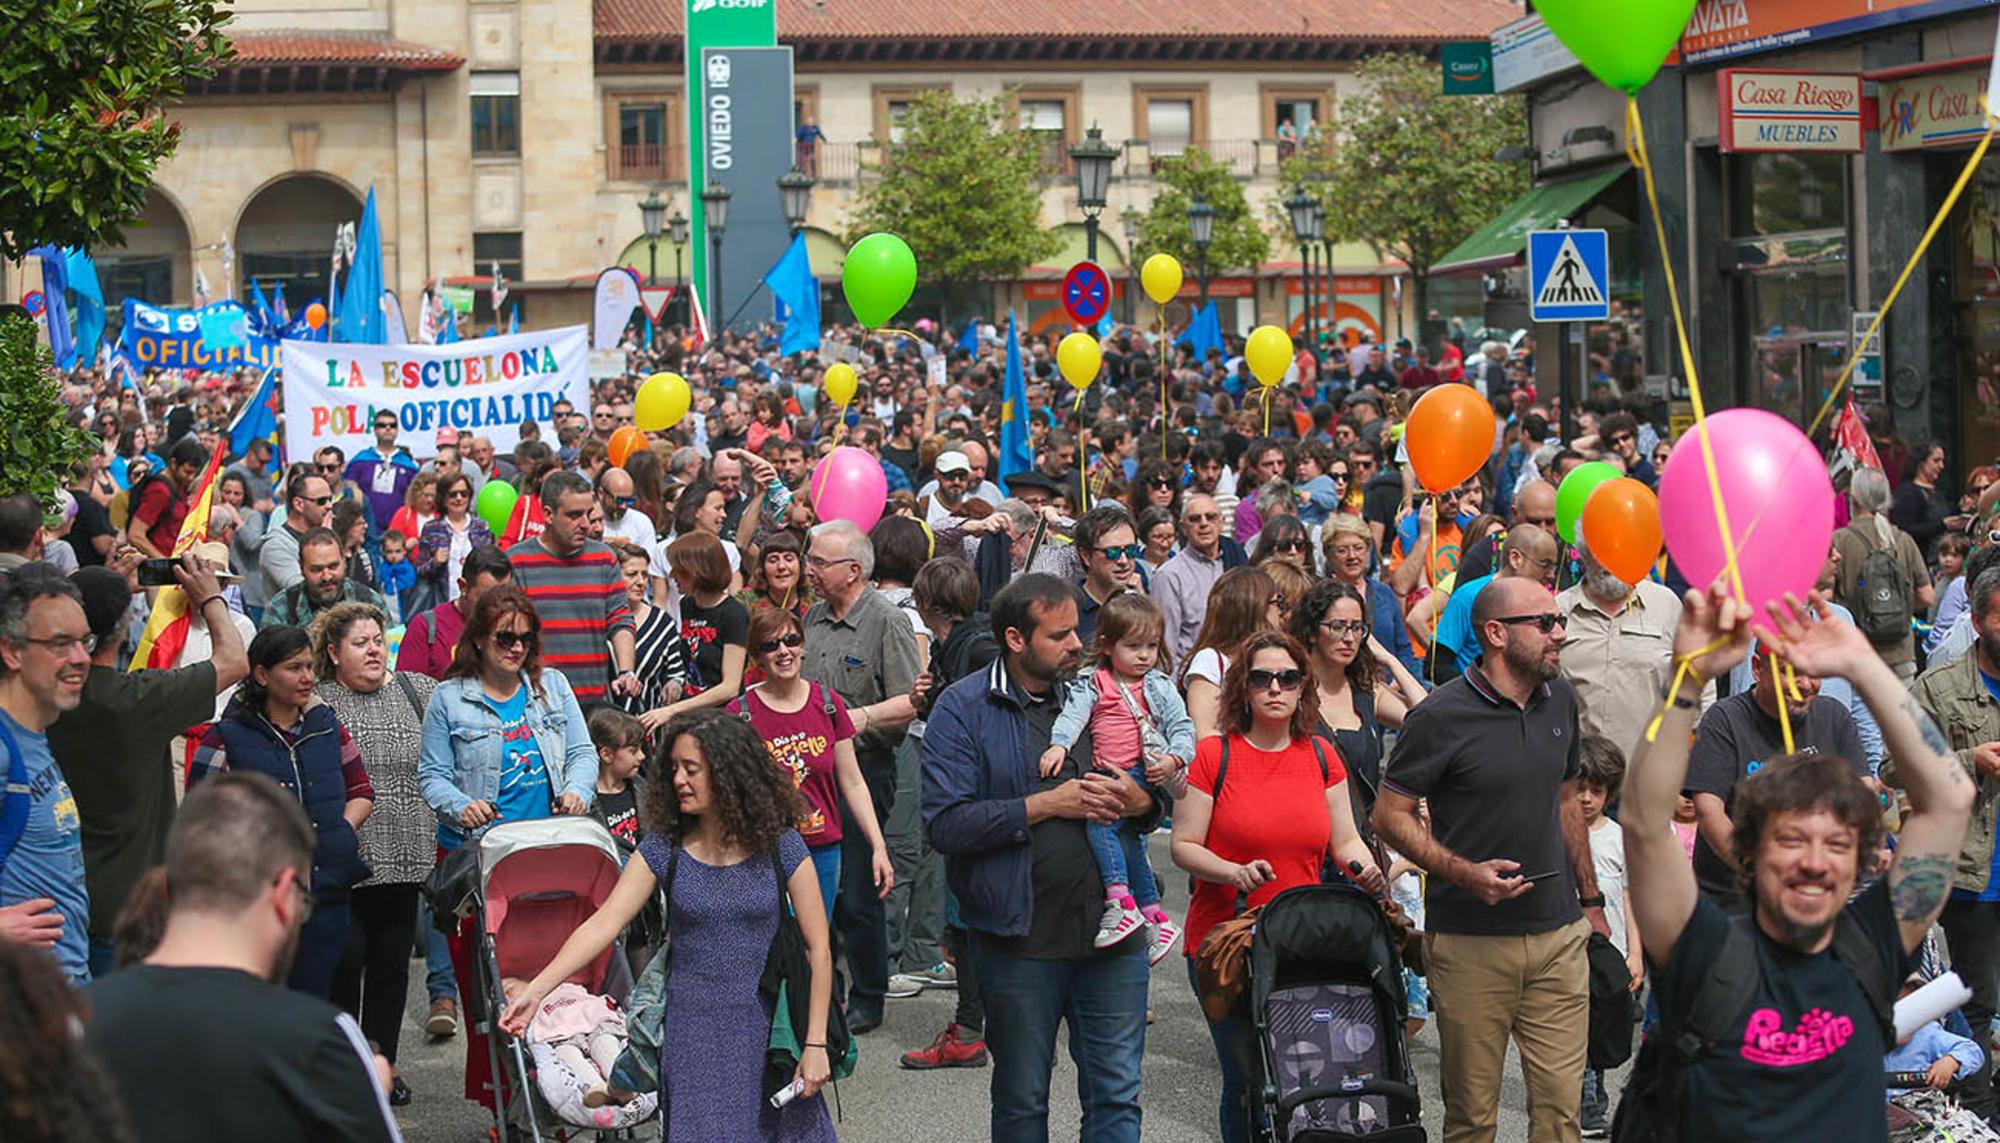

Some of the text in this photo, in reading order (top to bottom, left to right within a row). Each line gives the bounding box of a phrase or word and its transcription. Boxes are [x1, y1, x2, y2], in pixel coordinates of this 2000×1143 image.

[1737, 79, 1853, 110] Casa Riesgo
[1928, 83, 1969, 122] Casa
[710, 94, 732, 169] OVIEDO
[1755, 124, 1838, 142] MUEBLES
[327, 359, 366, 388] LA
[382, 345, 559, 389] ESCUELONA
